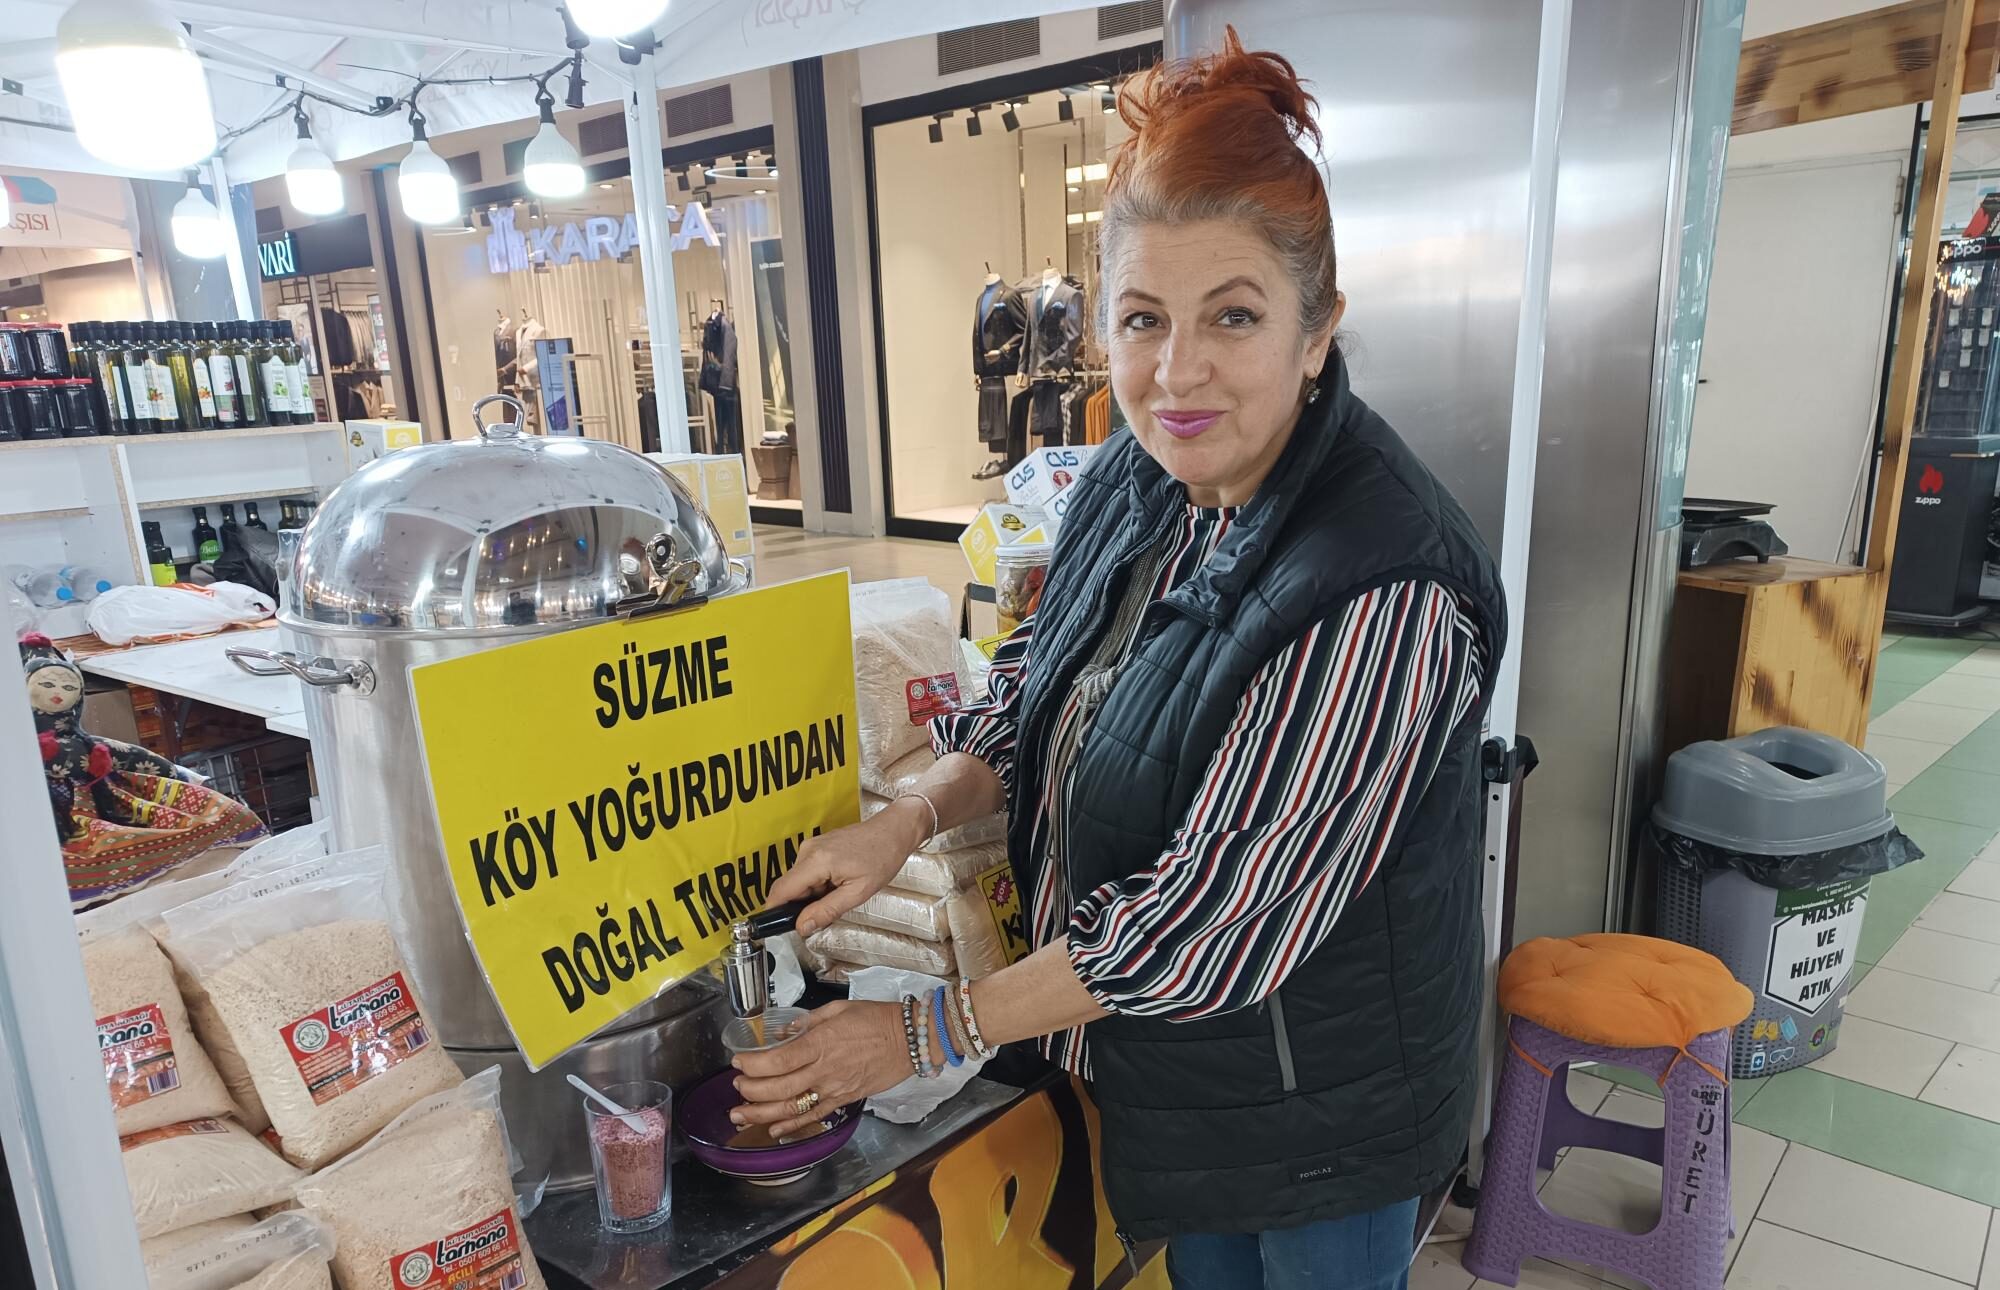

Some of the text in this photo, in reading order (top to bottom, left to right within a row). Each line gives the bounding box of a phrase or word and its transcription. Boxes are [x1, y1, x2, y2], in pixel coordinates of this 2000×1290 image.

[530, 201, 721, 265] KARAA
[257, 231, 296, 276] VARİ
[1915, 496, 1941, 505] zippo
[593, 635, 733, 729] SÜZME
[469, 713, 846, 908] KÖY YOĞURDUNDAN
[1801, 900, 1855, 926] MASKE
[1817, 927, 1837, 948] VE
[541, 898, 685, 1014] DOĞAL
[1790, 948, 1844, 979] HİJYEN
[1798, 977, 1833, 1002] ATIK
[436, 1226, 507, 1266] tarhana
[458, 1255, 477, 1268] 0507
